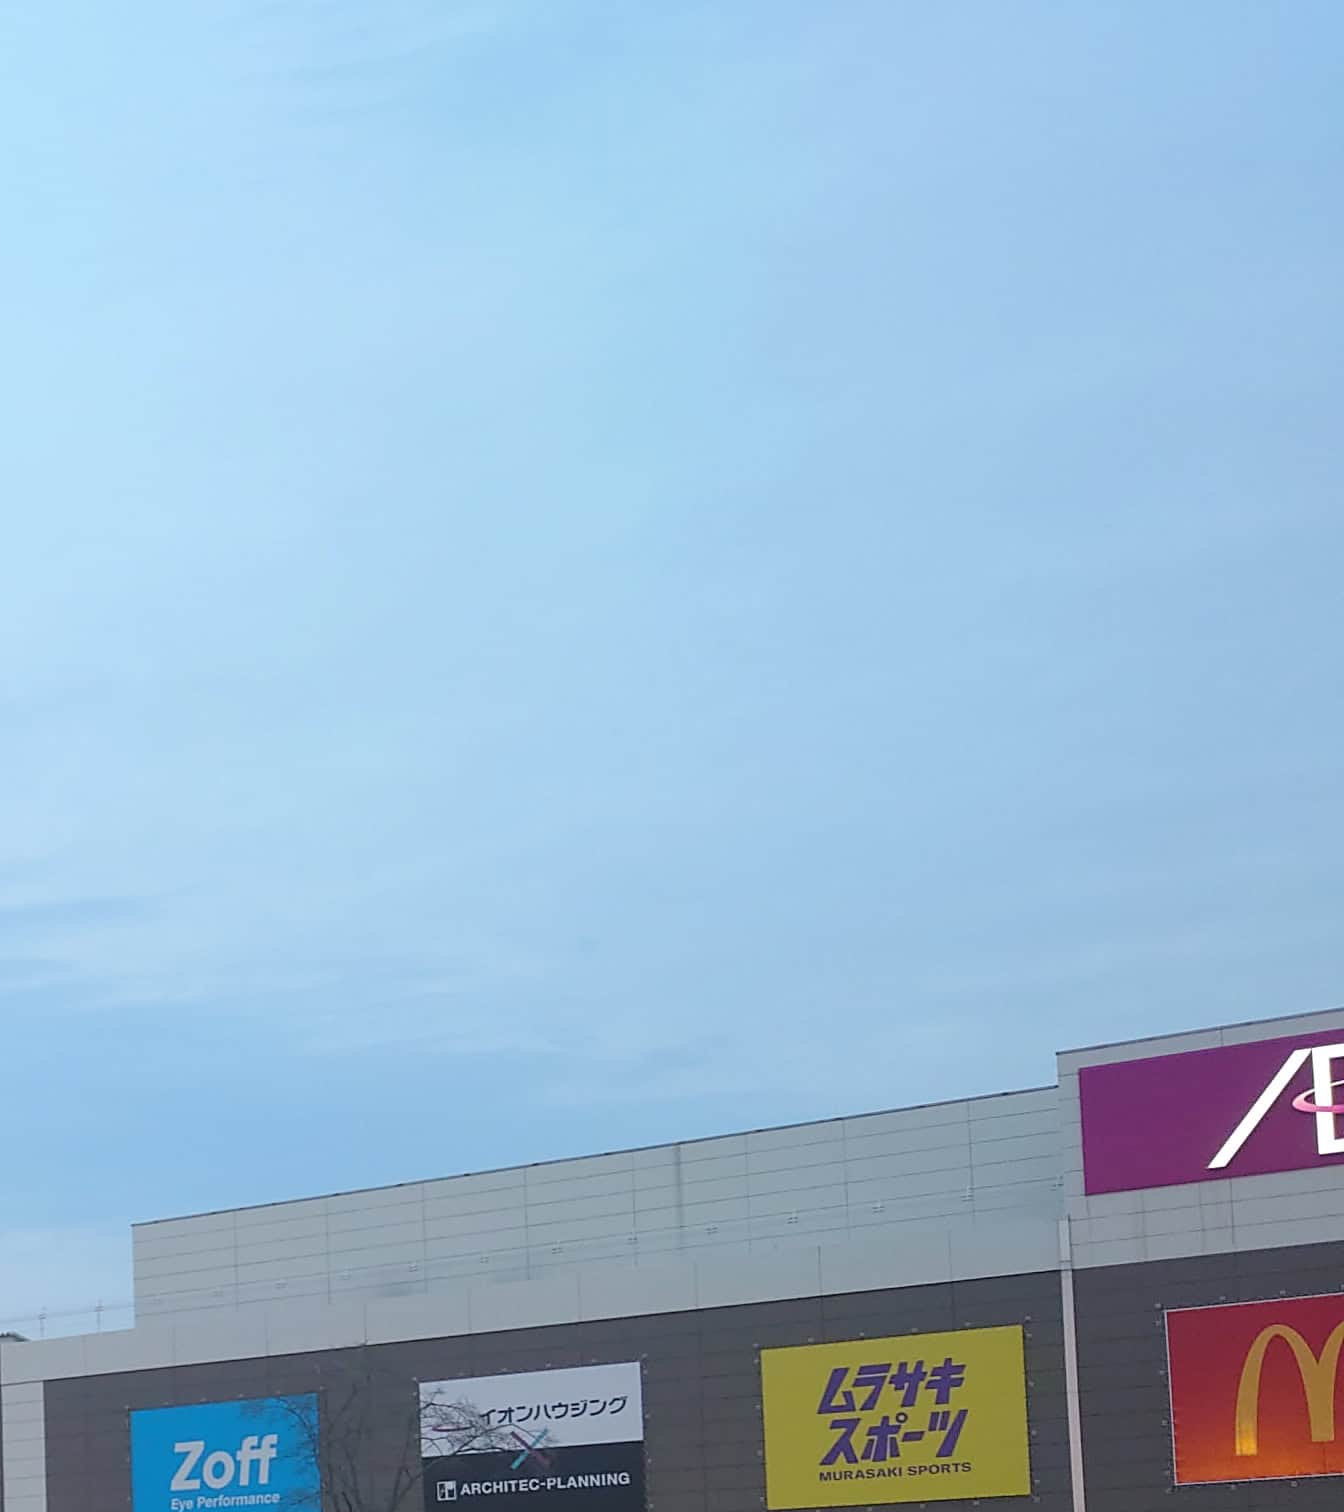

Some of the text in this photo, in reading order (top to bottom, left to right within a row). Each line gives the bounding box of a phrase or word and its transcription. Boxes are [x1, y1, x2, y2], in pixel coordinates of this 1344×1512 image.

[817, 1358, 967, 1414] ムラサキ
[480, 1396, 628, 1425] イオンハウジング
[819, 1409, 968, 1466] スポーツ
[170, 1434, 278, 1491] Zoff
[819, 1462, 972, 1482] MURASAKI SPORTS
[460, 1472, 630, 1496] ARCHITEC-PLANNING
[171, 1493, 280, 1512] Eye Performance
